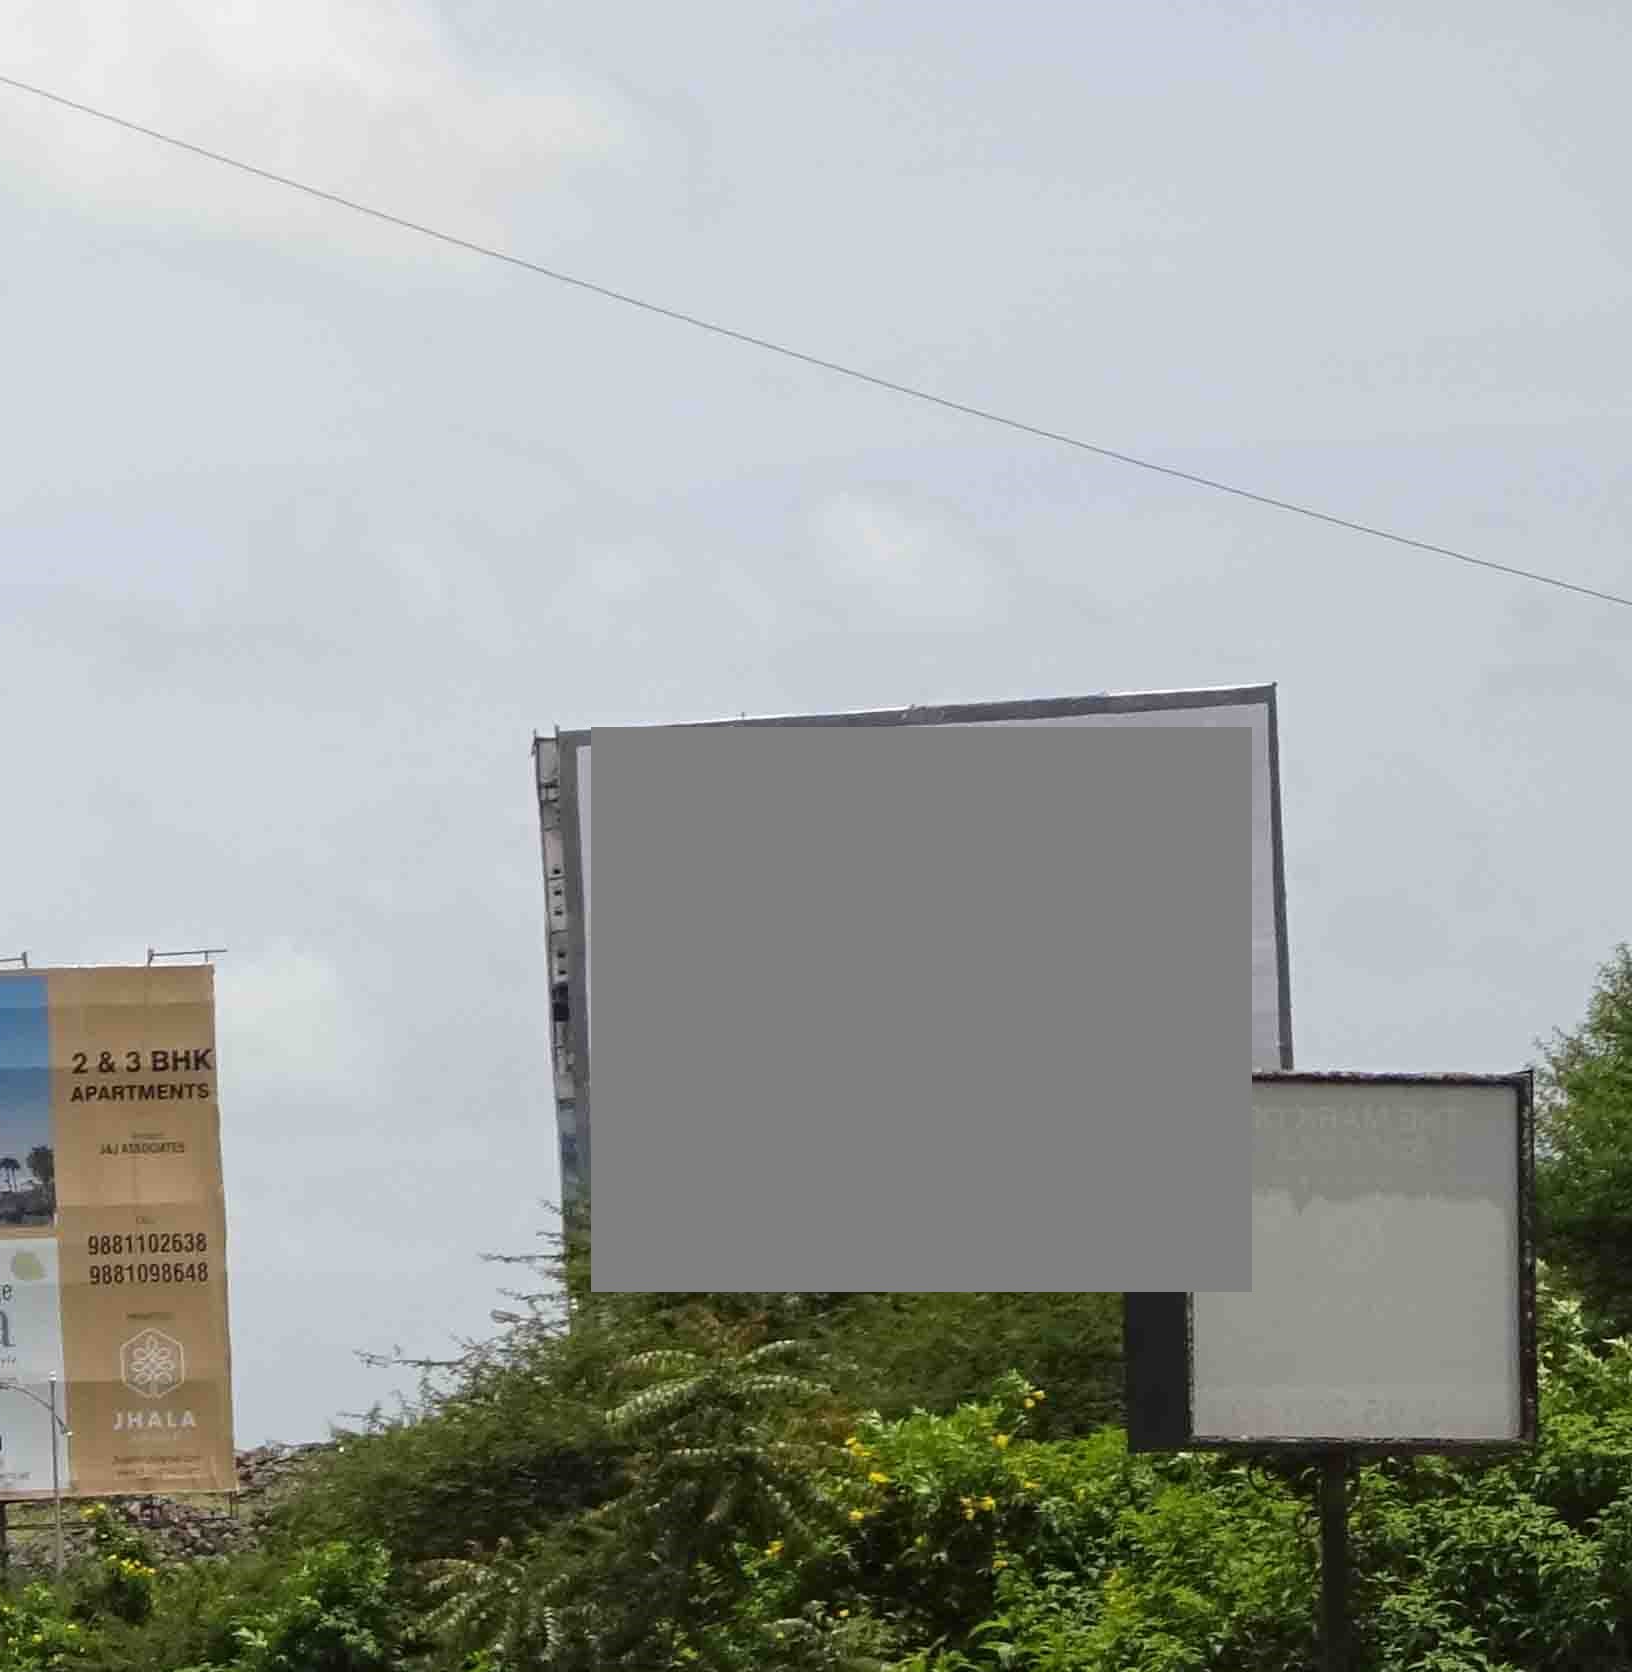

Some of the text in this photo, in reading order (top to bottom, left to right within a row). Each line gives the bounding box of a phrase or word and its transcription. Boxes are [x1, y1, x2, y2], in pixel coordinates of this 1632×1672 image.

[71, 1048, 214, 1075] 2 & 3 BHK
[69, 1082, 210, 1103] APARTMENTS
[87, 1232, 207, 1256] 9881102638
[112, 1410, 198, 1432] JHALA
